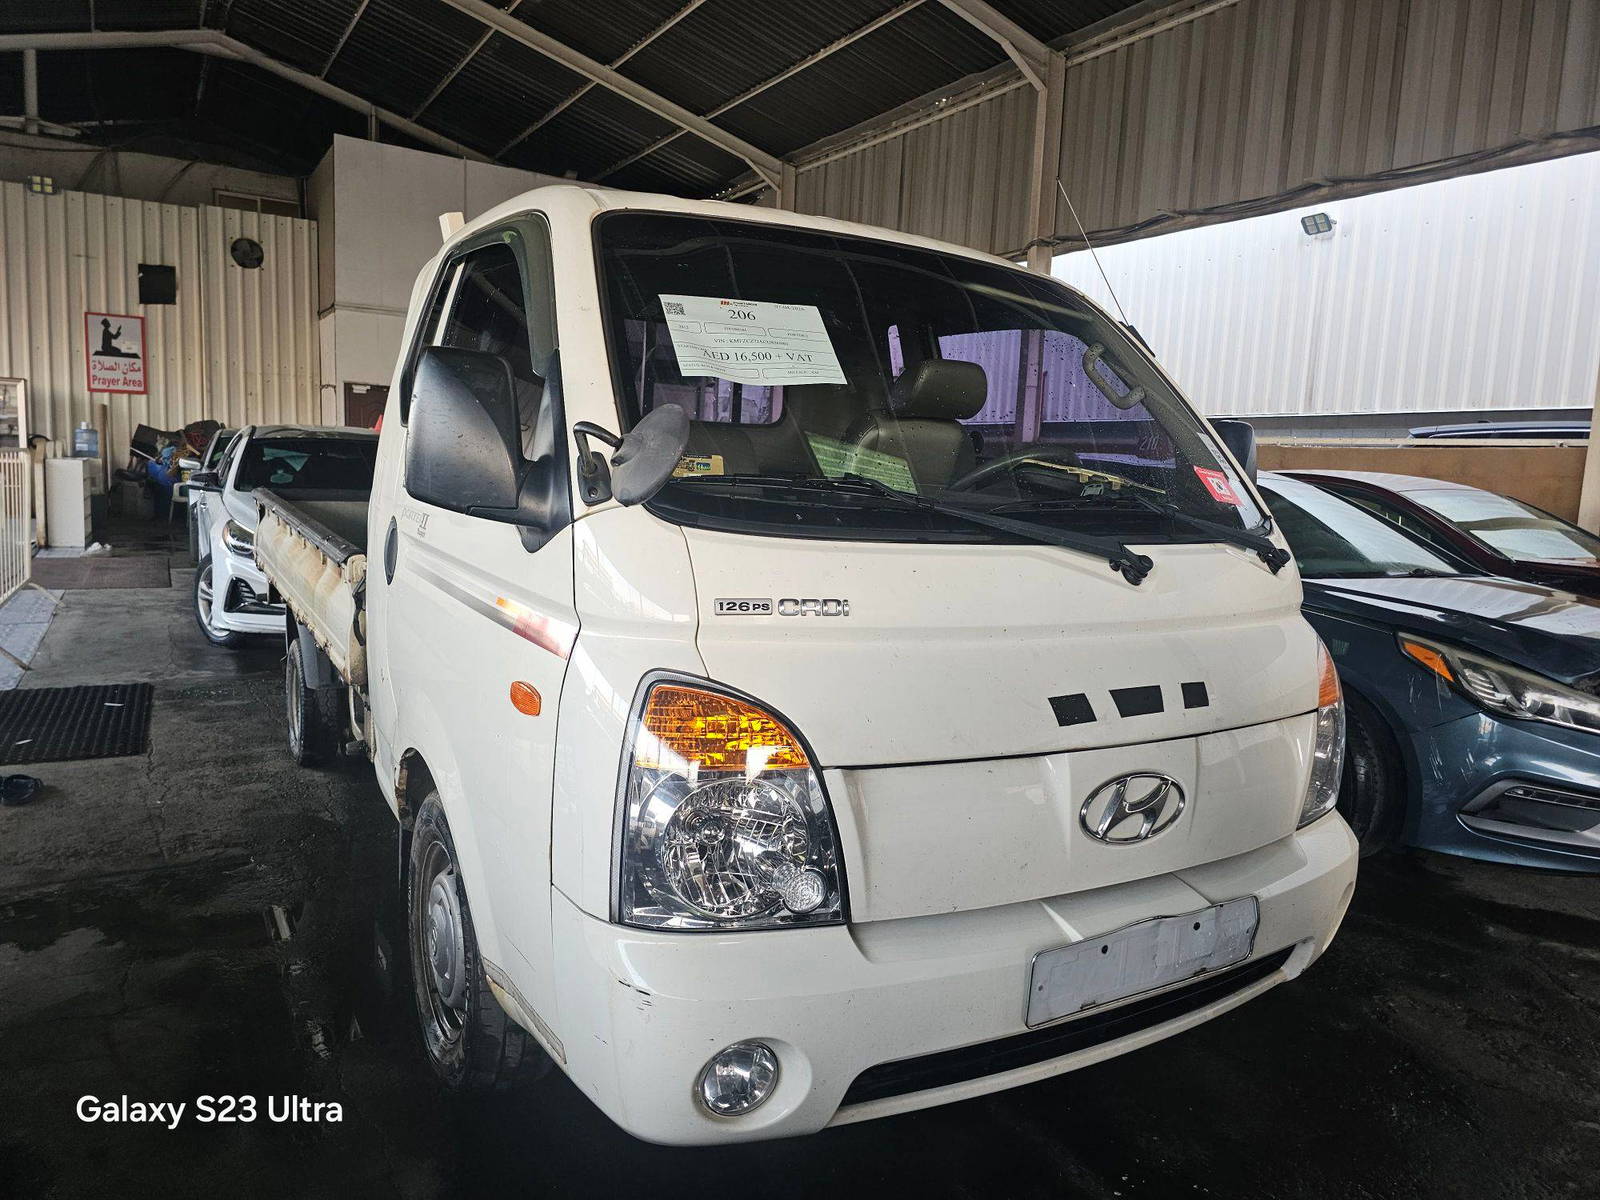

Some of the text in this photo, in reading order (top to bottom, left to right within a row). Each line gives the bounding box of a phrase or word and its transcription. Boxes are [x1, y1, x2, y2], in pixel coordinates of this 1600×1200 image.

[729, 309, 756, 321] 206
[703, 350, 730, 361] AED
[735, 351, 772, 362] 16,500
[786, 352, 815, 362] VAT
[91, 360, 141, 375] مكان الصلاة
[92, 375, 143, 388] Prayer Area
